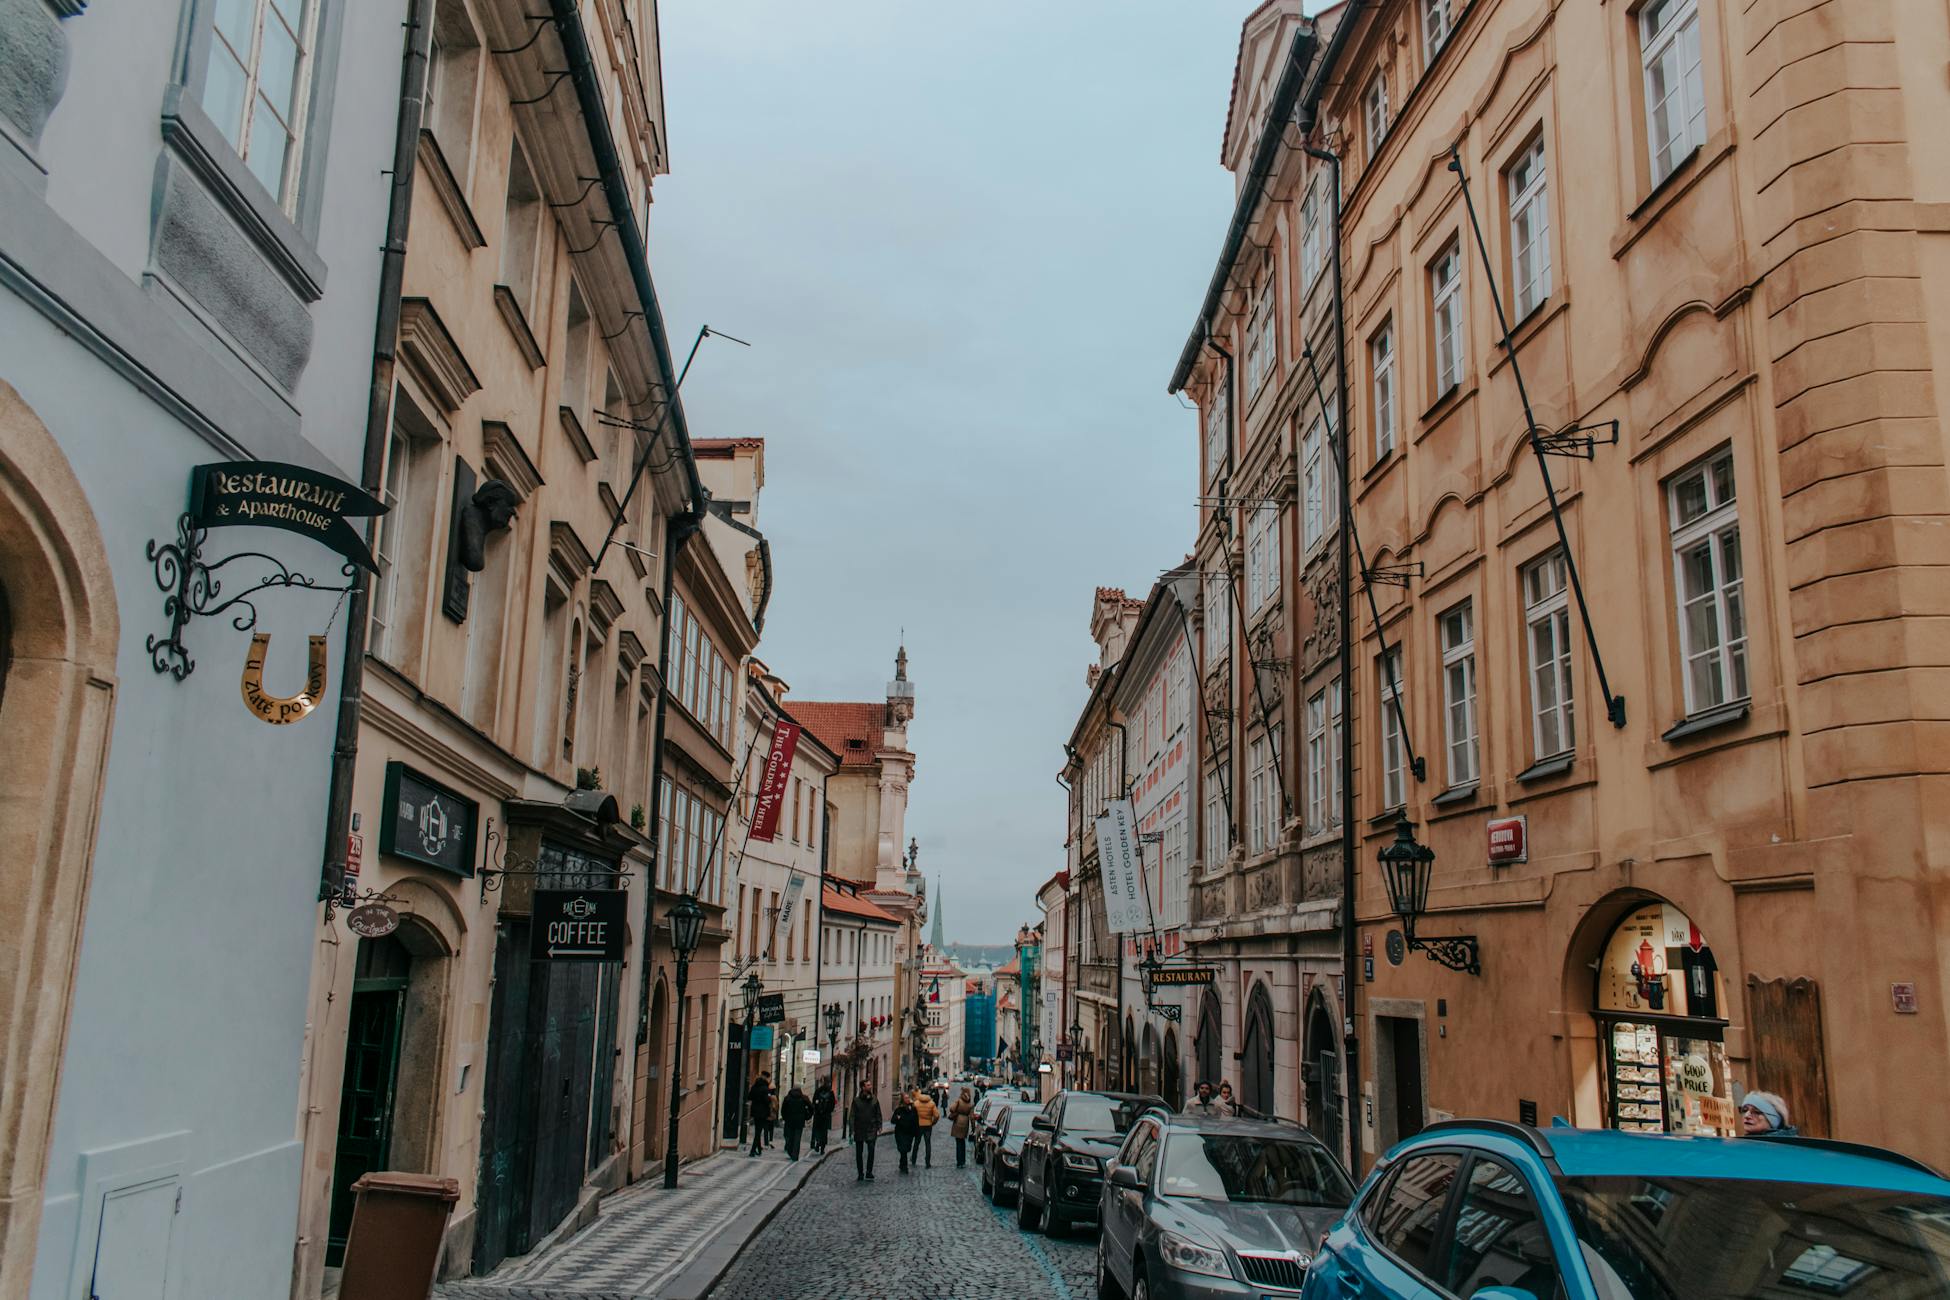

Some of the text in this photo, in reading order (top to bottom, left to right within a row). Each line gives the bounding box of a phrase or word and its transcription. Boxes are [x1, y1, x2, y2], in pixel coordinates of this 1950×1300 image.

[215, 504, 230, 516] &
[1117, 809, 1136, 900] HOTEL GOLDEN KEY
[1104, 836, 1118, 895] ASTEN HOTELS
[548, 921, 608, 945] COFFEE
[1153, 972, 1211, 982] RESTAURANT
[1684, 1063, 1706, 1078] GOOD
[1684, 1078, 1708, 1093] PRICE
